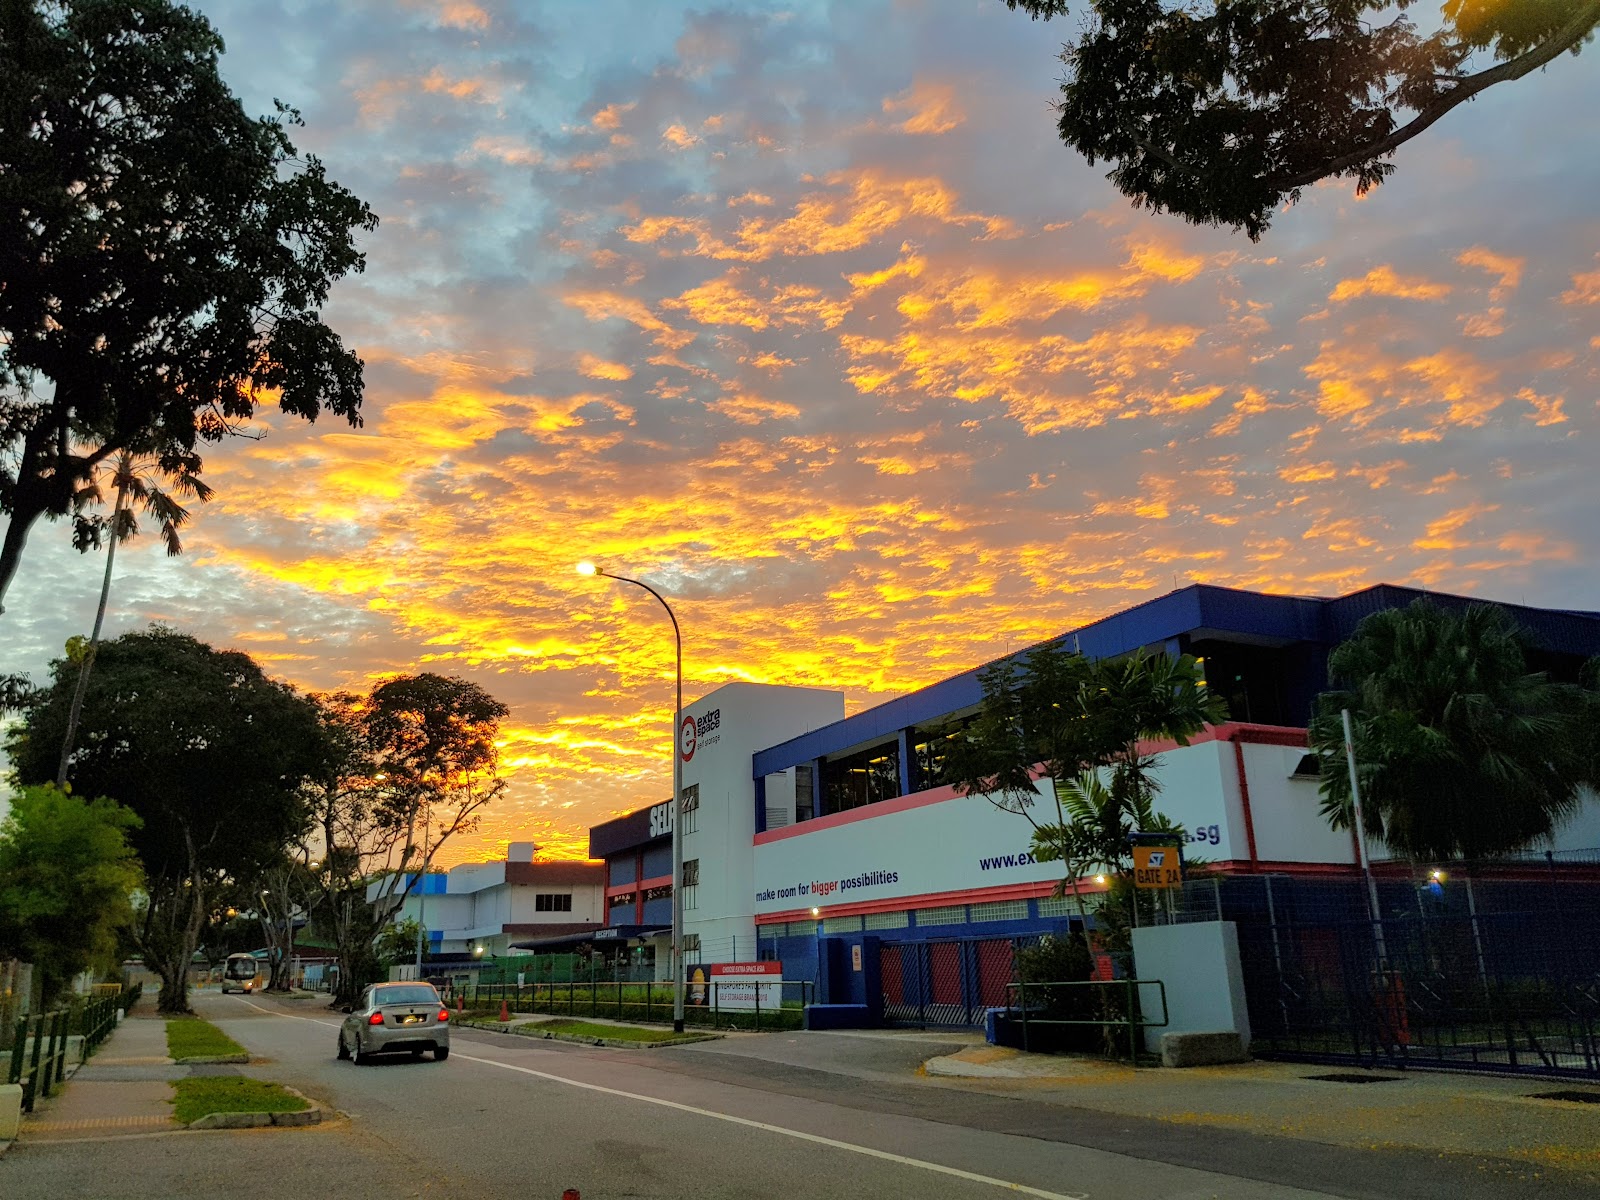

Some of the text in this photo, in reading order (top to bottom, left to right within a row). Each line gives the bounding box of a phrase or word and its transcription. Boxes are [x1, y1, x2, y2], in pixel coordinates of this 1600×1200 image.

[697, 709, 720, 727] extra
[697, 719, 720, 737] space
[705, 735, 720, 747] storage
[979, 852, 1036, 871] www.ex
[1137, 869, 1180, 884] GATE 2A
[756, 869, 899, 902] make room for bigger possibilities
[595, 929, 618, 939] RECEPTION
[735, 965, 745, 973] EXTRA
[745, 965, 756, 973] SPACE
[756, 965, 765, 973] ASIA
[716, 980, 744, 990] INGAPORES
[719, 993, 728, 1001] SELF
[728, 993, 743, 1001] STORAGE
[744, 993, 756, 1001] BRAN
